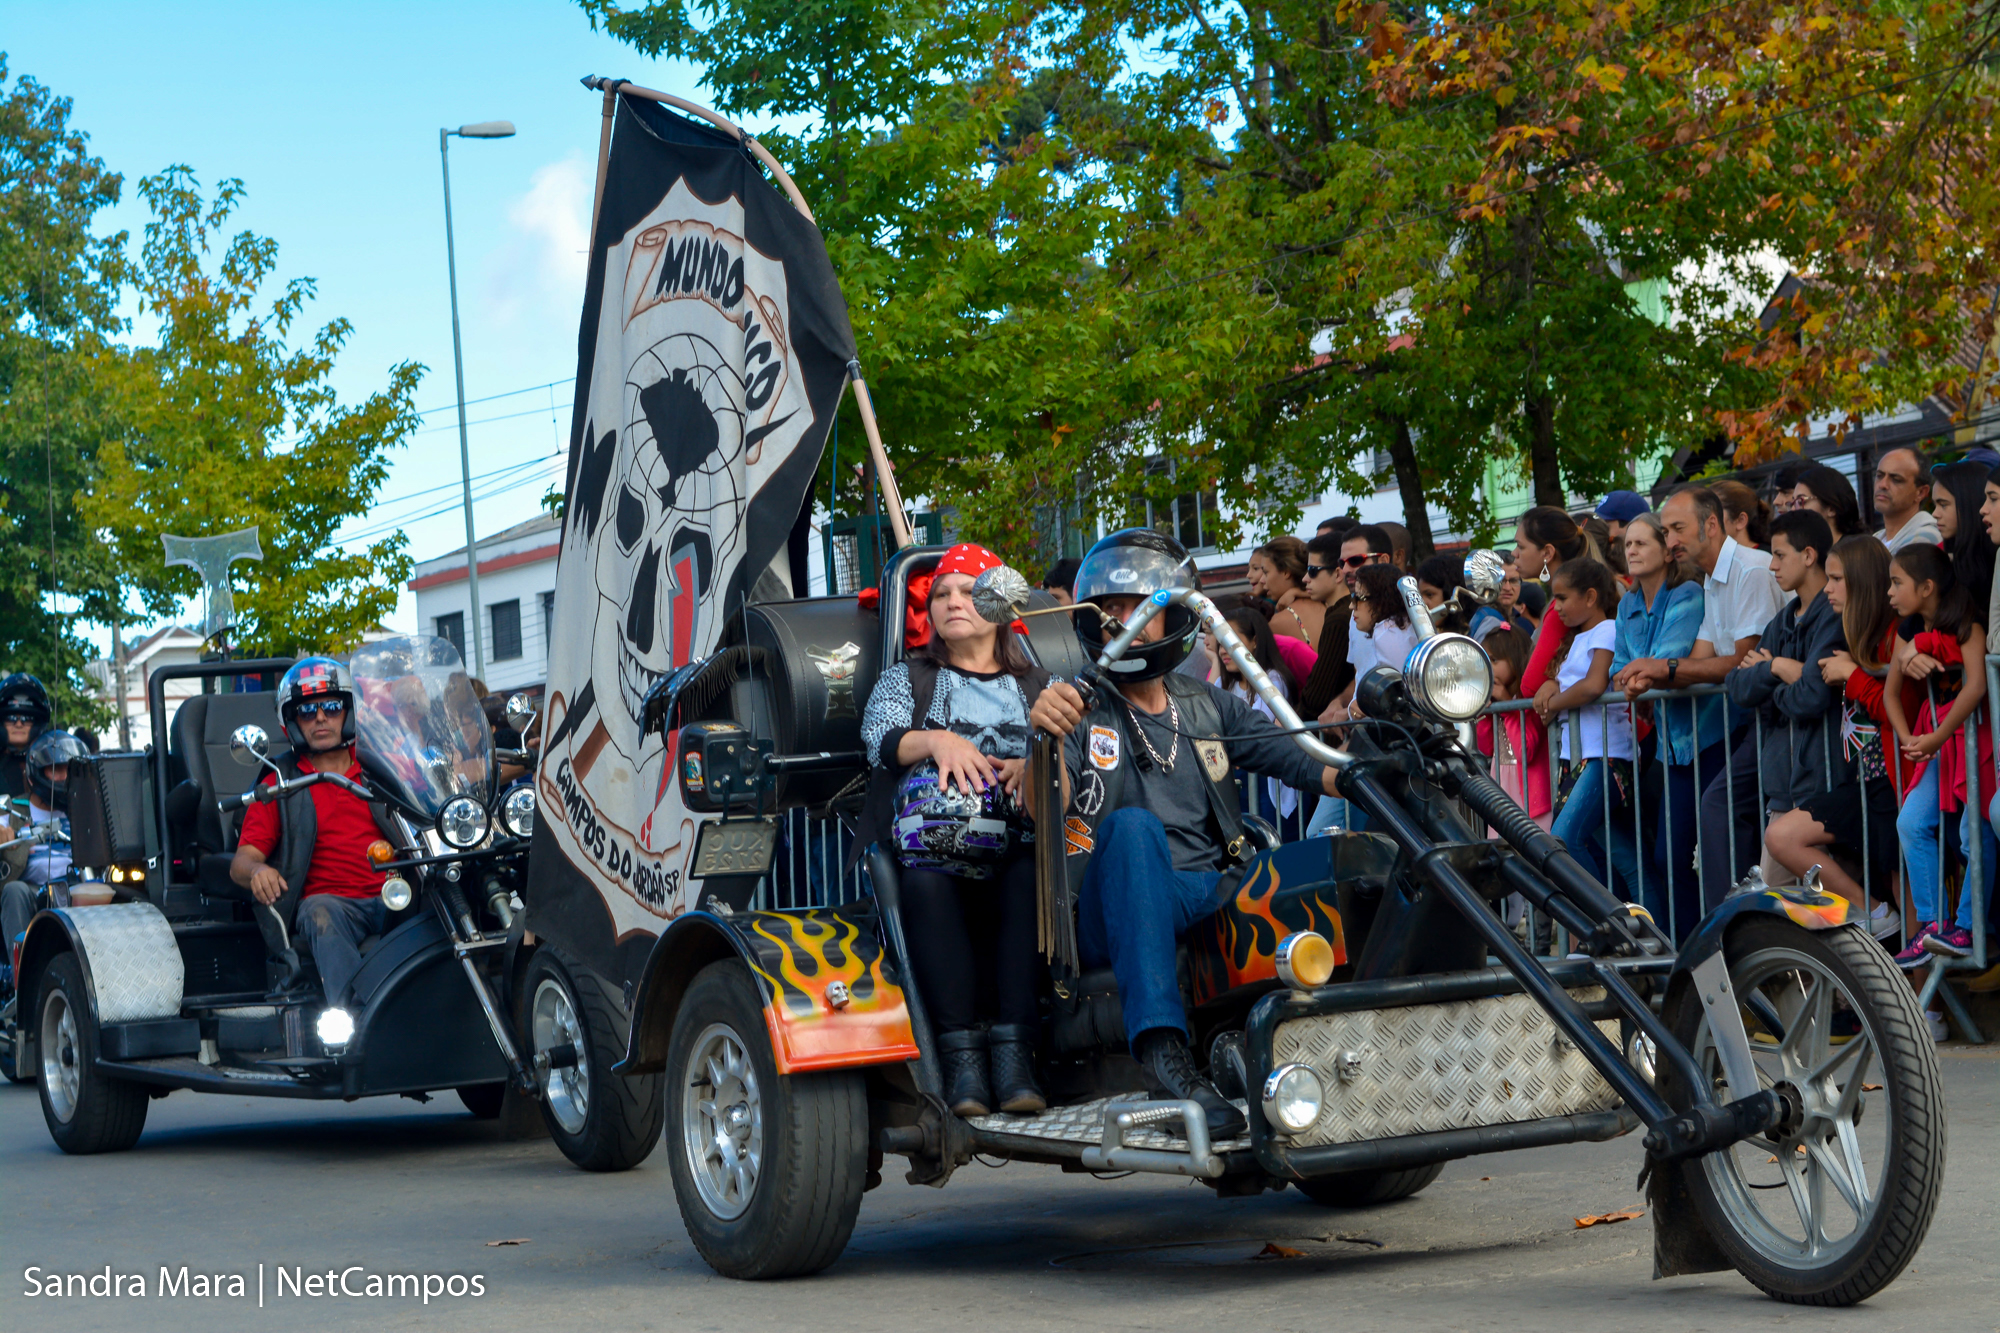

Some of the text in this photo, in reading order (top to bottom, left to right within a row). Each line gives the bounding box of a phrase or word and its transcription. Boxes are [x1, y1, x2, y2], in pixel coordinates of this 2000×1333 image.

[653, 236, 745, 312] MUNDO
[556, 757, 606, 861] CAMPOS
[607, 838, 632, 880] DO
